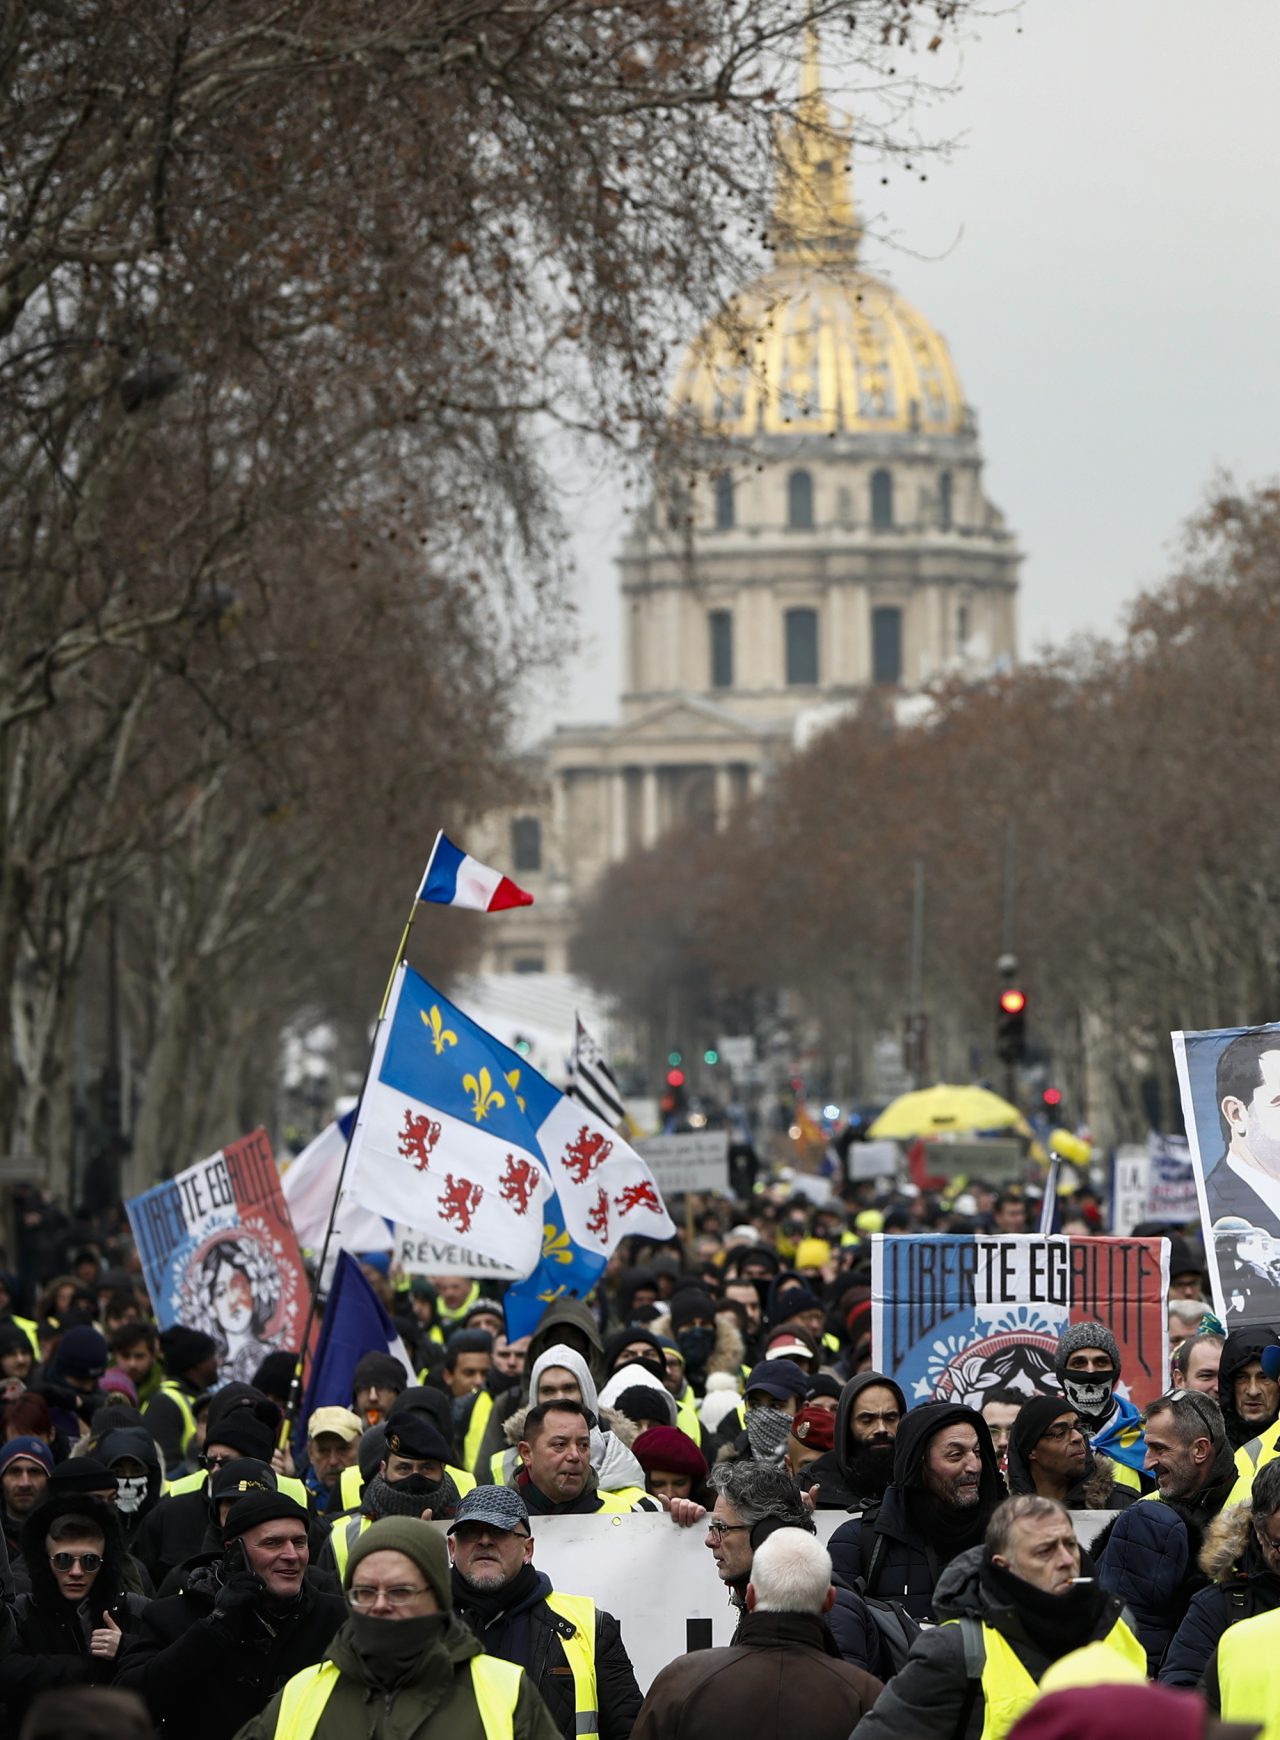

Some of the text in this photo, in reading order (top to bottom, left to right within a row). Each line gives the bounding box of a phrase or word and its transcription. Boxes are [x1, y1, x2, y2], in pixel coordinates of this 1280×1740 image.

[134, 1135, 291, 1298] LIBERTE EGALITE
[892, 1242, 1153, 1378] LIBERTE EGALITE
